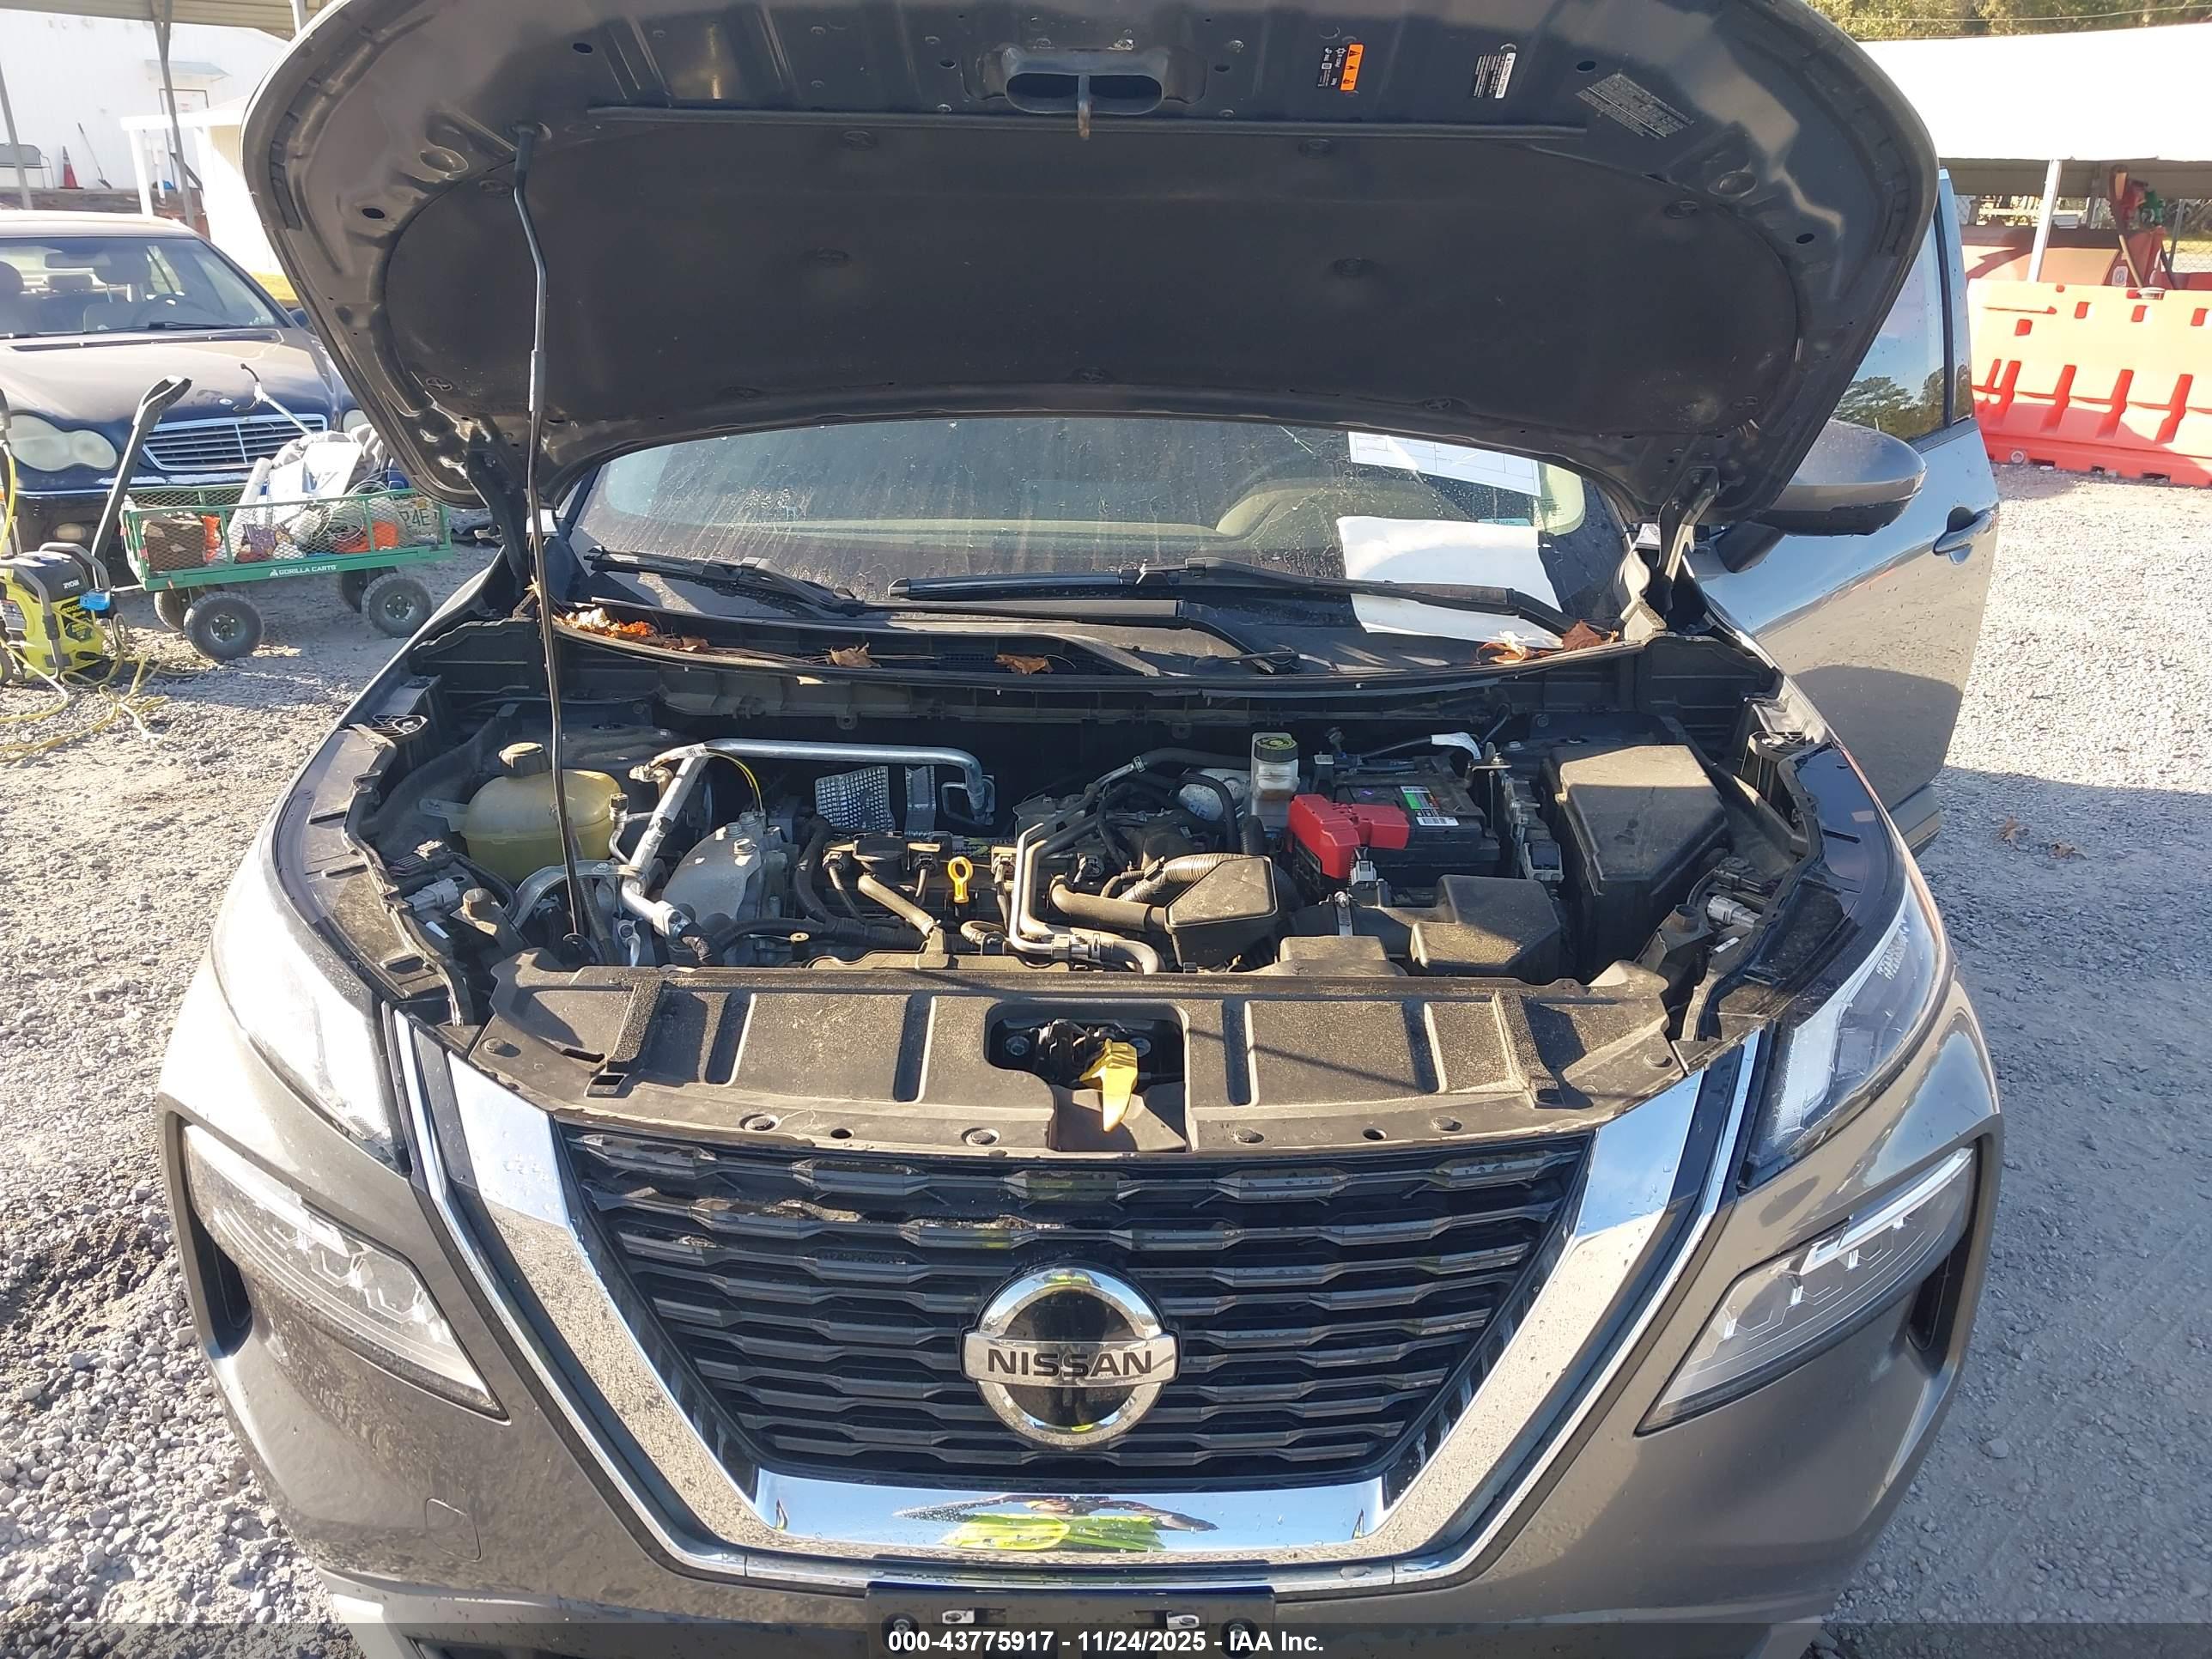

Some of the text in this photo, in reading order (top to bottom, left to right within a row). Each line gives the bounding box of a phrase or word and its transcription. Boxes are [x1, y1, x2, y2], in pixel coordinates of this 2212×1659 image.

[278, 564, 337, 575] GORILLA CARTS
[988, 1348, 1152, 1377] NISSAN
